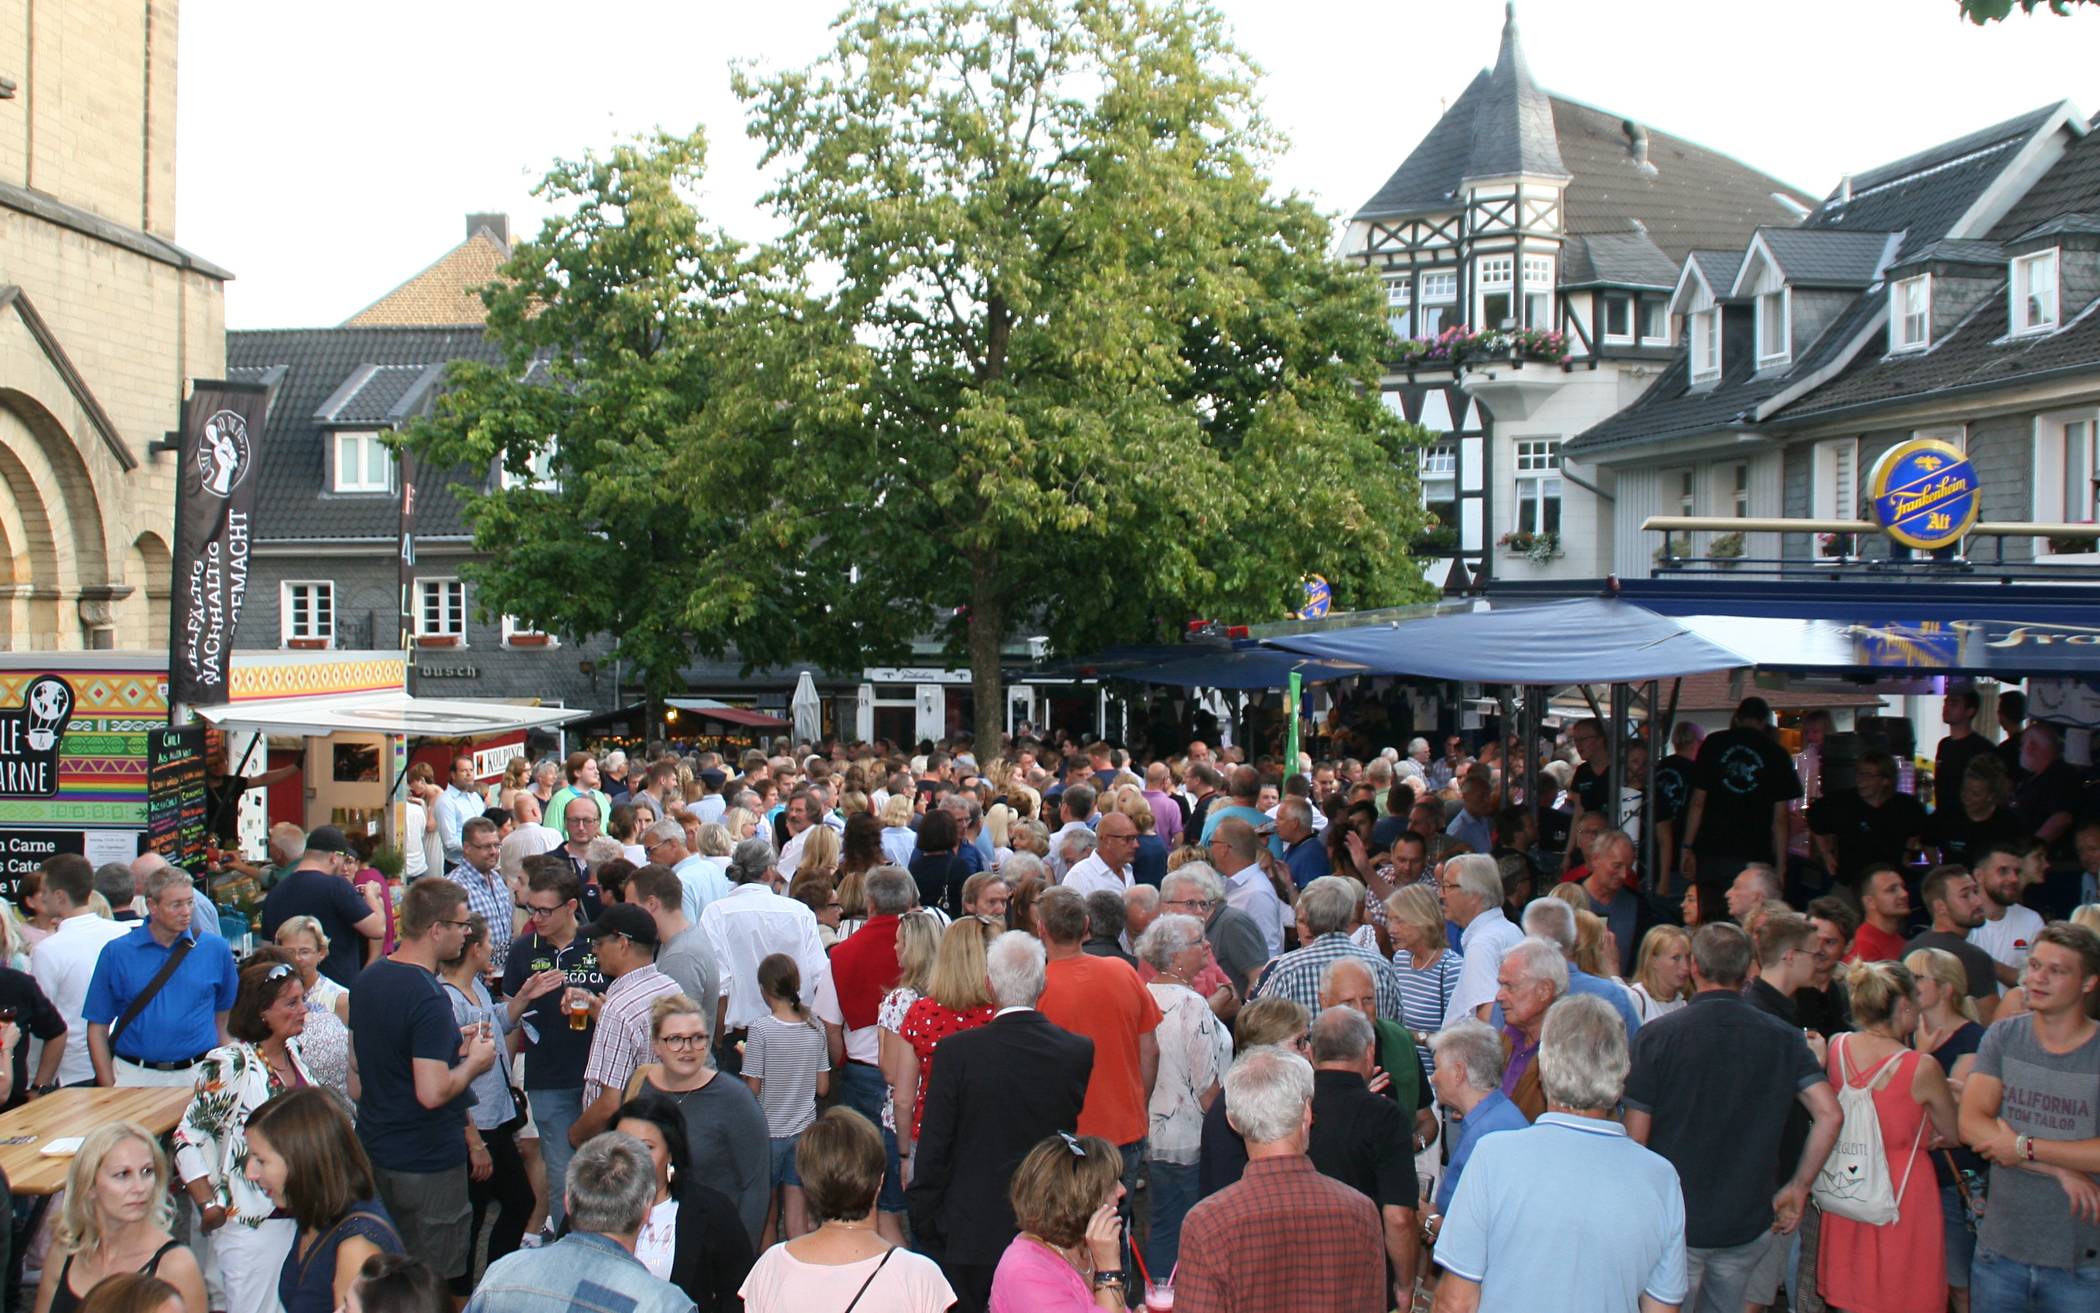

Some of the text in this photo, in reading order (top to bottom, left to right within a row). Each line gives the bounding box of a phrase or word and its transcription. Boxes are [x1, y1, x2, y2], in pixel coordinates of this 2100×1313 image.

[1890, 475, 1968, 521] Frankenheim
[1926, 511, 1951, 530] Alt
[203, 541, 222, 685] NACHHALTIG
[9, 838, 55, 852] Carne
[2007, 1106, 2076, 1131] TOM TAILOR
